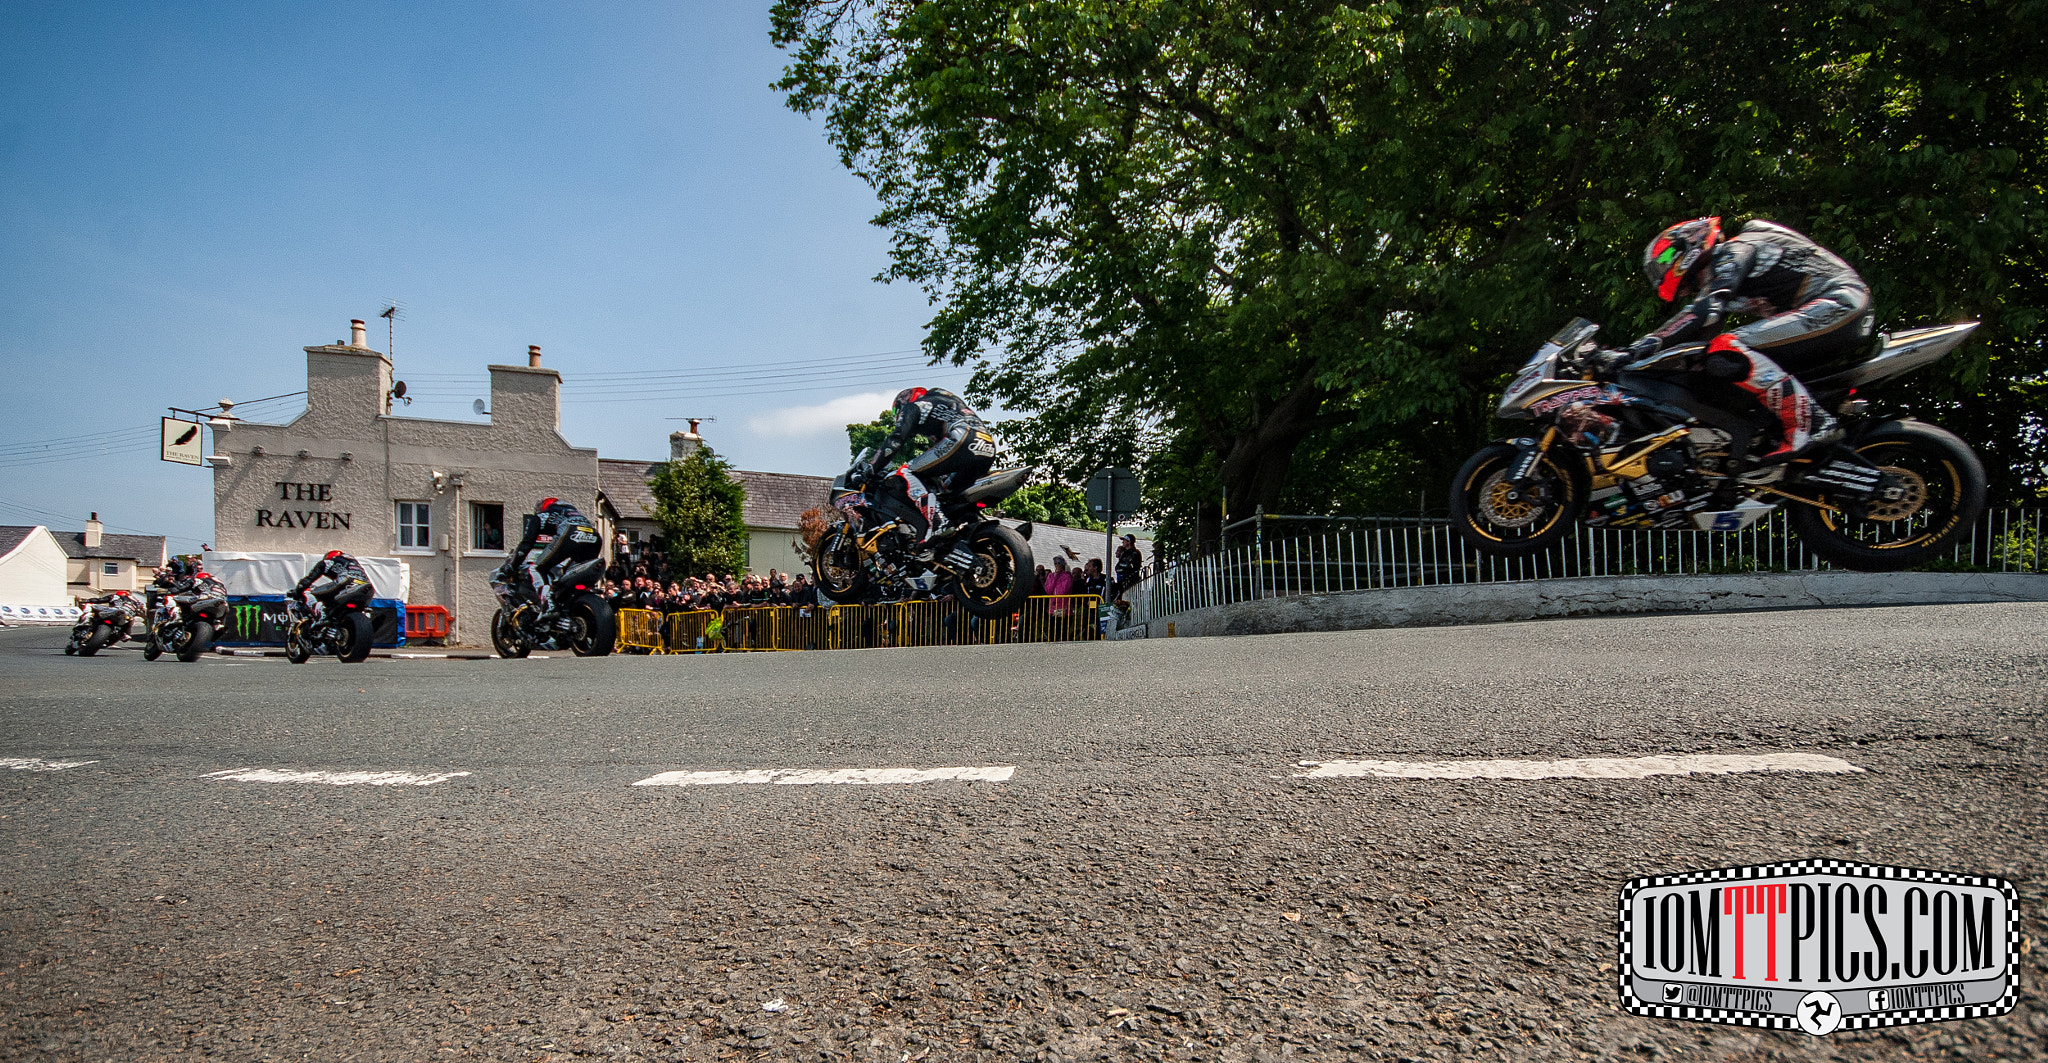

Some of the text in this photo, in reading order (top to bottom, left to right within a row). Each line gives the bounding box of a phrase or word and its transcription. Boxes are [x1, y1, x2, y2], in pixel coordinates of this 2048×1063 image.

[179, 452, 199, 460] RAVEN
[275, 482, 333, 502] THE
[255, 509, 352, 530] RAVEN
